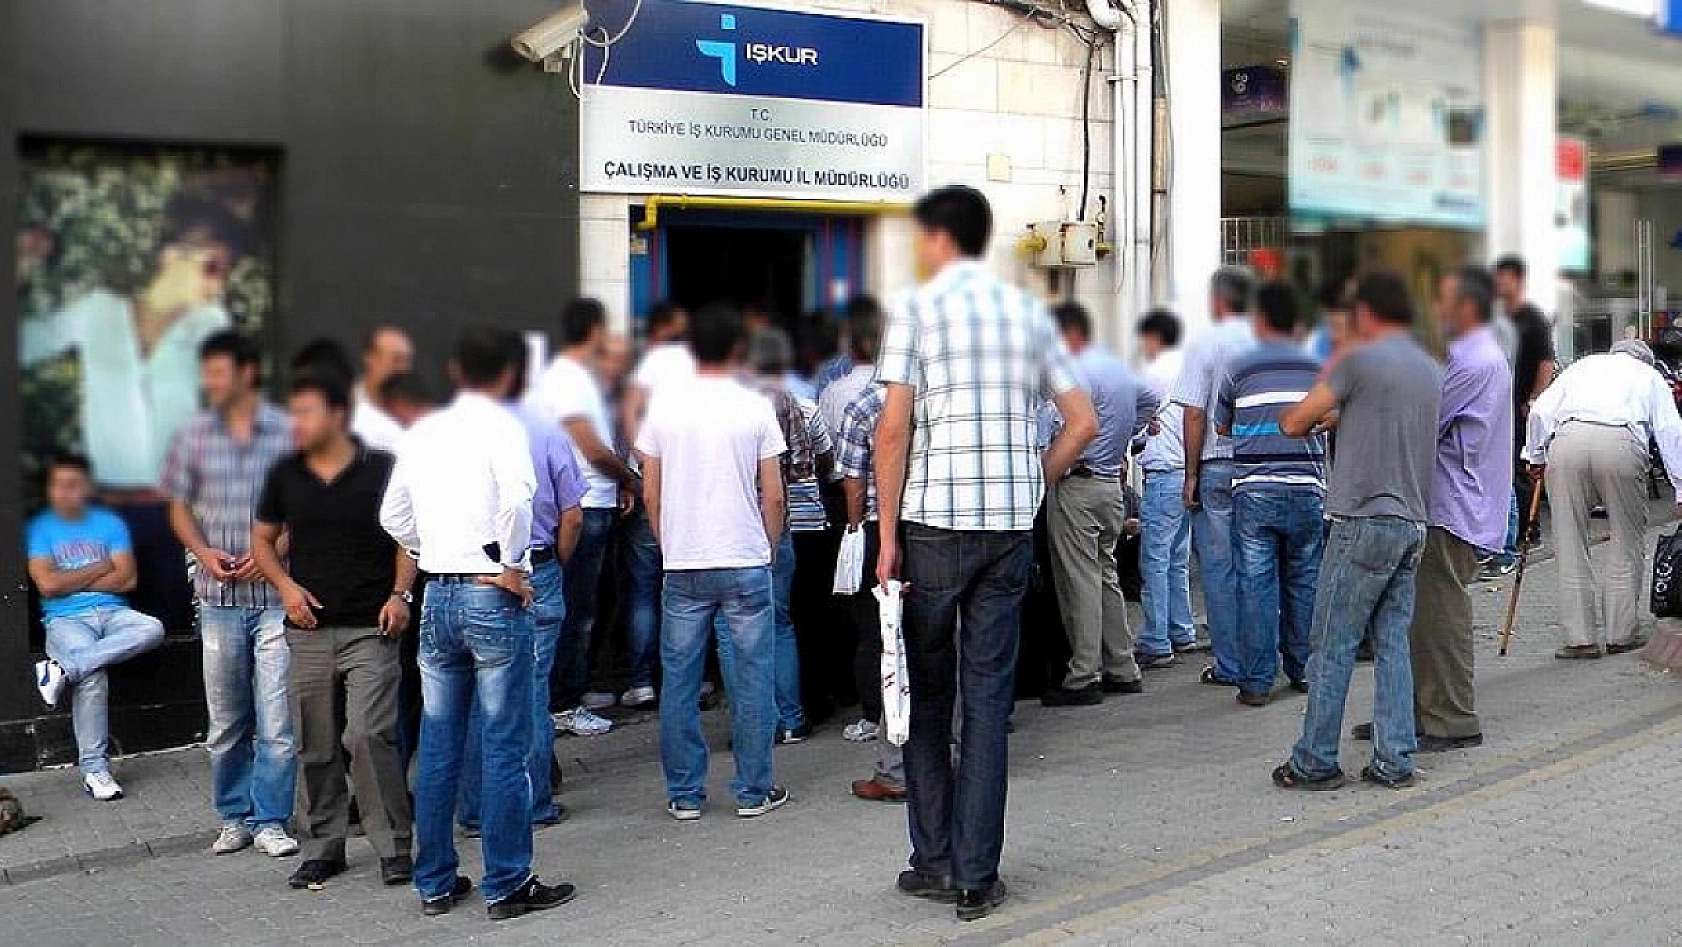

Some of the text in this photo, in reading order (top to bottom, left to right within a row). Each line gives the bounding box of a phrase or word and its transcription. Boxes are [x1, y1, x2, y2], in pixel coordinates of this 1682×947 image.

[750, 108, 772, 122] T.C.
[628, 119, 889, 147] TÜRKİYE İŞ KURUMU GENEL MÜDÜRLÜĞÜ
[604, 161, 909, 190] ÇALIŞMA VE İŞ KURUMU İL MÜDÜRLÜĞÜ
